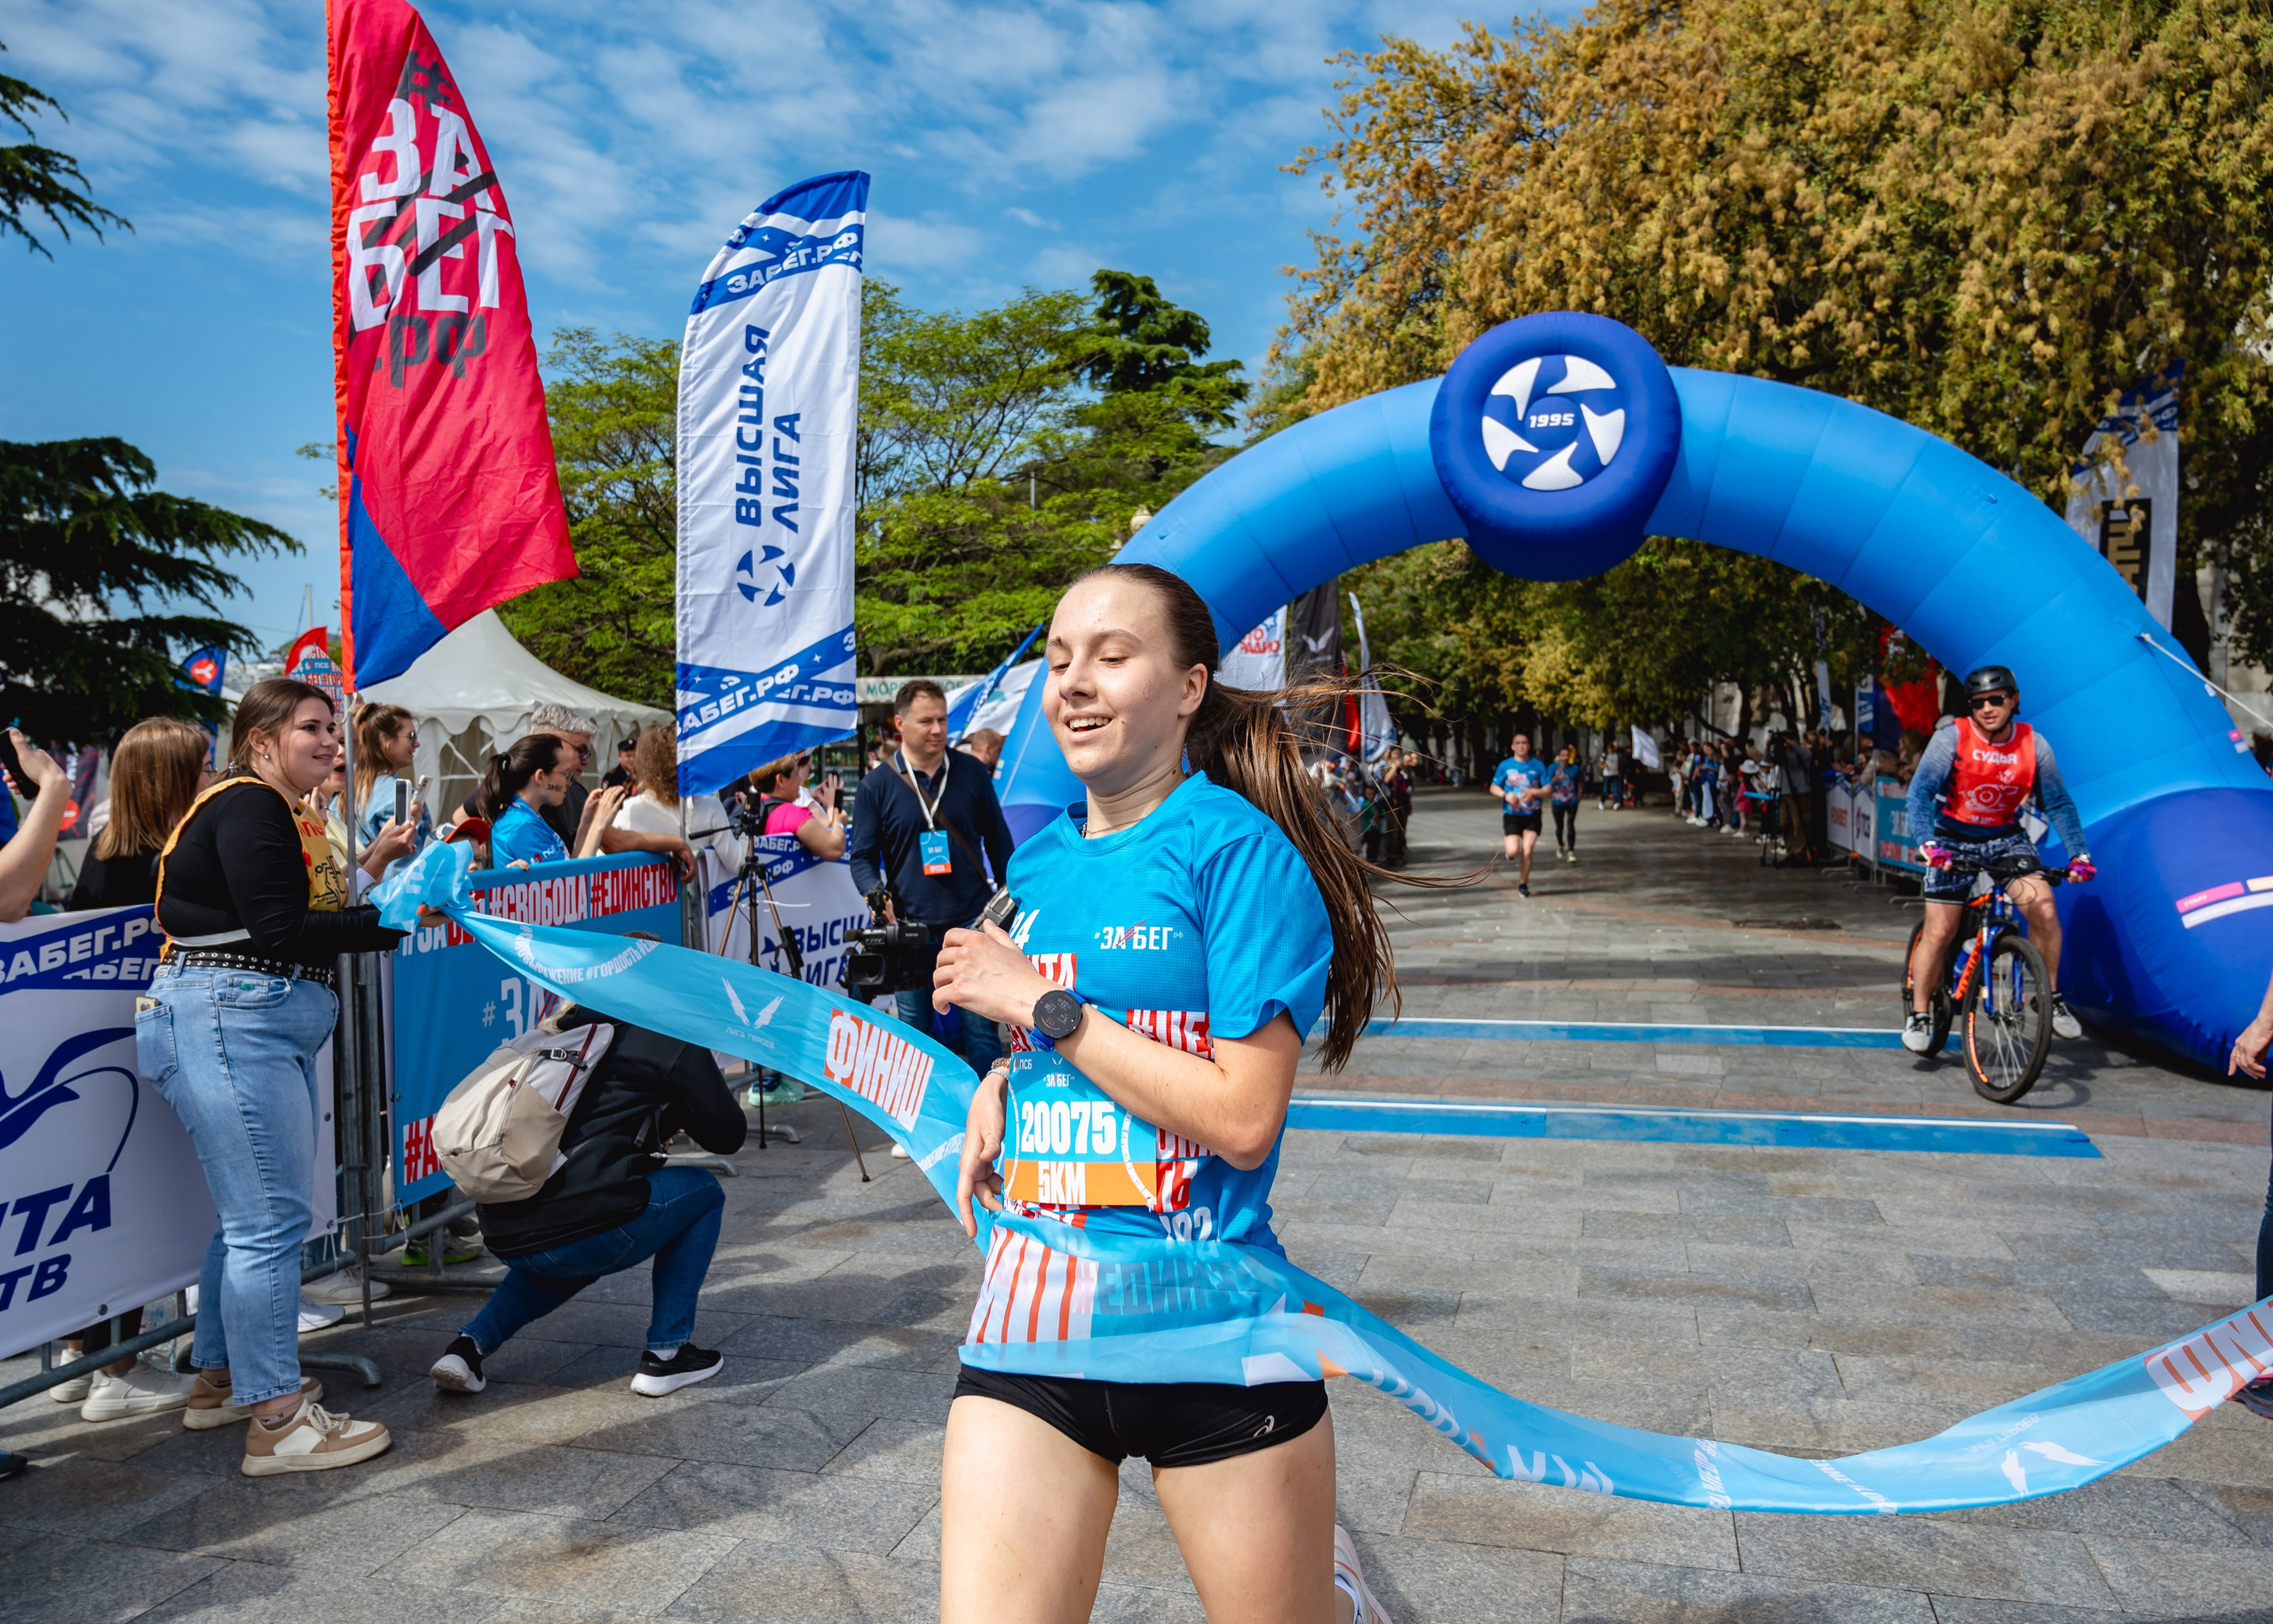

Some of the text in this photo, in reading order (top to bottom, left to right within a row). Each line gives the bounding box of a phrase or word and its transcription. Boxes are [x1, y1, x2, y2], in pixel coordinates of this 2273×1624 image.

[360, 98, 497, 212] ЗА
[347, 197, 515, 333] БЕГ
[735, 324, 771, 527] ВЫСШАЯ
[1529, 413, 1575, 429] 1995
[772, 412, 801, 535] ЛИГА
[1972, 749, 2018, 764] СУДЬЯ
[755, 837, 802, 852] ЗАБЕГ.Р
[590, 863, 677, 918] #ЕДИНСТВО
[792, 914, 867, 955] ВЫСШ
[725, 1026, 775, 1049] ЛИГА ГЕРОЕВ
[1019, 1058, 1033, 1070] ПСБ
[826, 1010, 935, 1133] ФИНИШ
[1020, 1100, 1117, 1155] 20075
